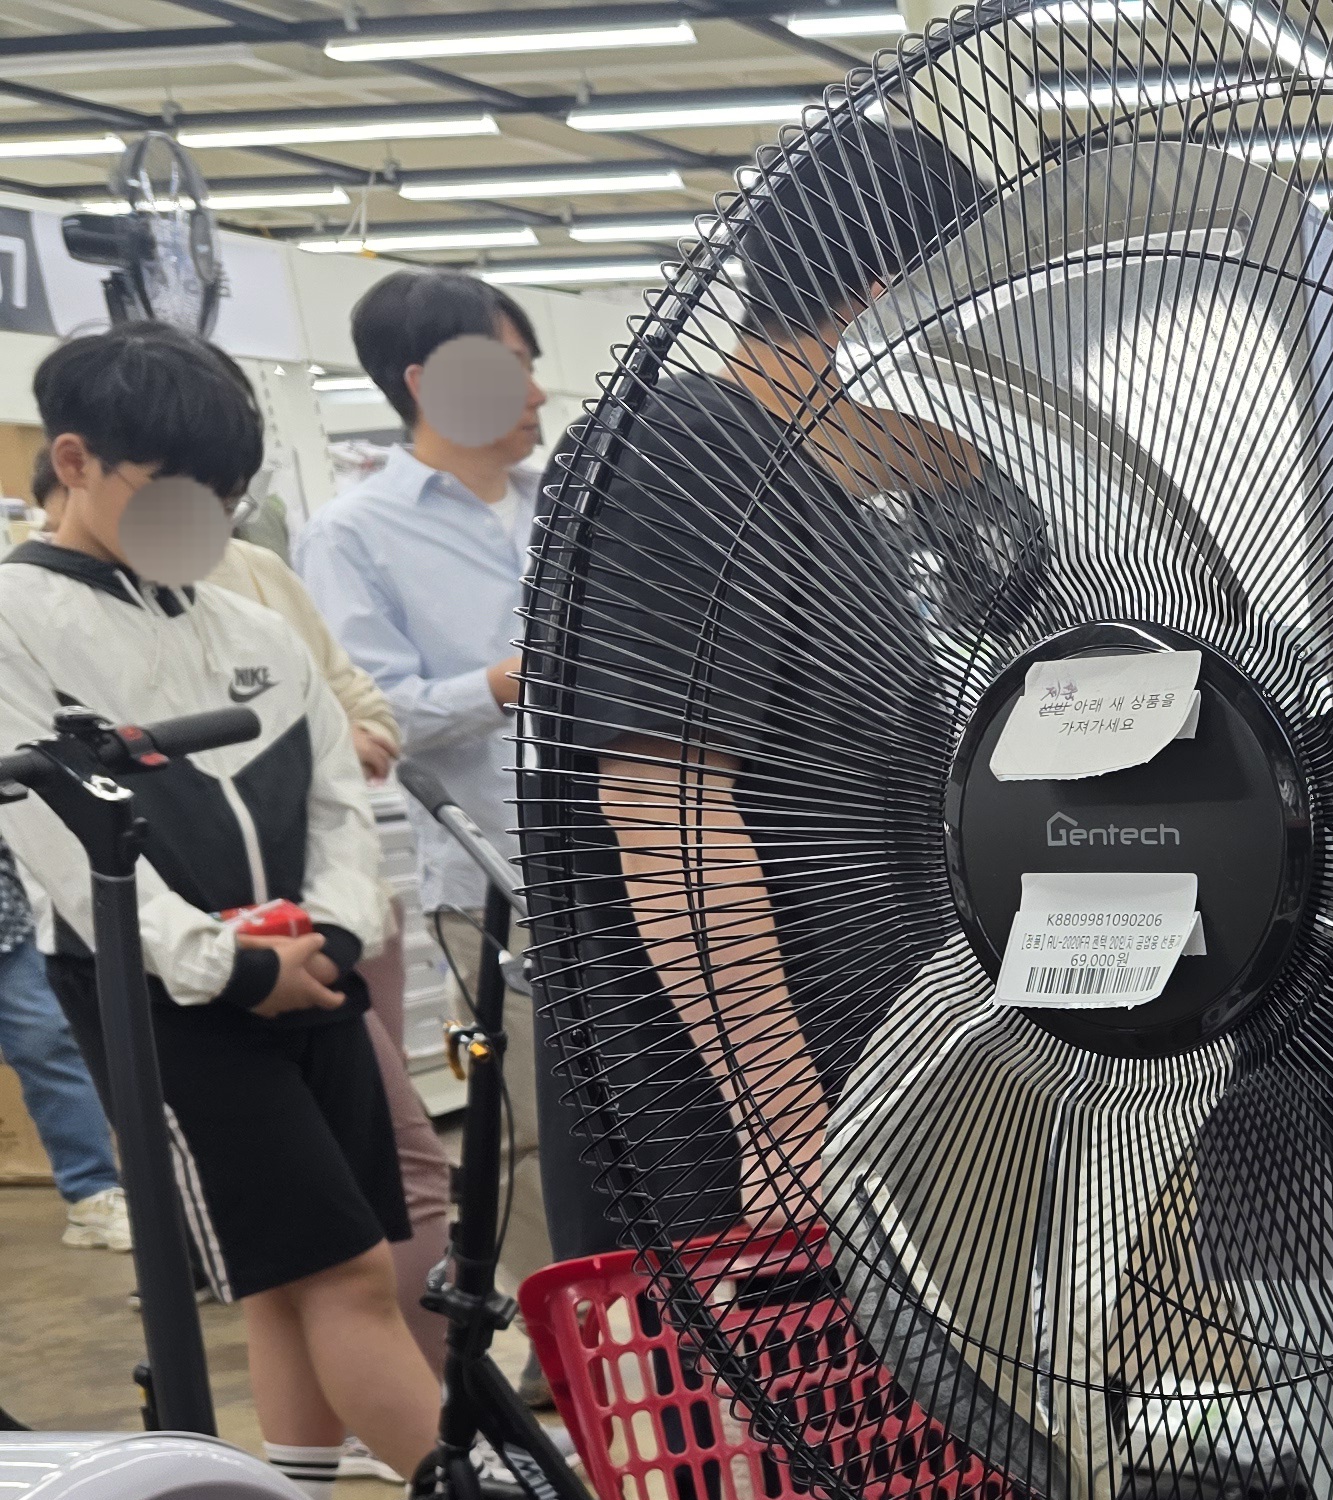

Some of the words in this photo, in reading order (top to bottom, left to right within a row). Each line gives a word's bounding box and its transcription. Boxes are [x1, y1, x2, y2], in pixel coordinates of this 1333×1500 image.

[233, 667, 271, 686] NIKE
[1074, 698, 1101, 714] 아래
[1109, 696, 1125, 711] 새
[1131, 693, 1175, 710] 상품을
[1059, 718, 1134, 735] 가져가세요
[1046, 811, 1181, 847] Gentech
[1046, 913, 1163, 927] K8809981090206
[1021, 932, 1046, 951] [정품]
[1109, 934, 1134, 950] 20인치
[1136, 934, 1159, 950] 공업용
[1070, 952, 1130, 968] 69,000원
